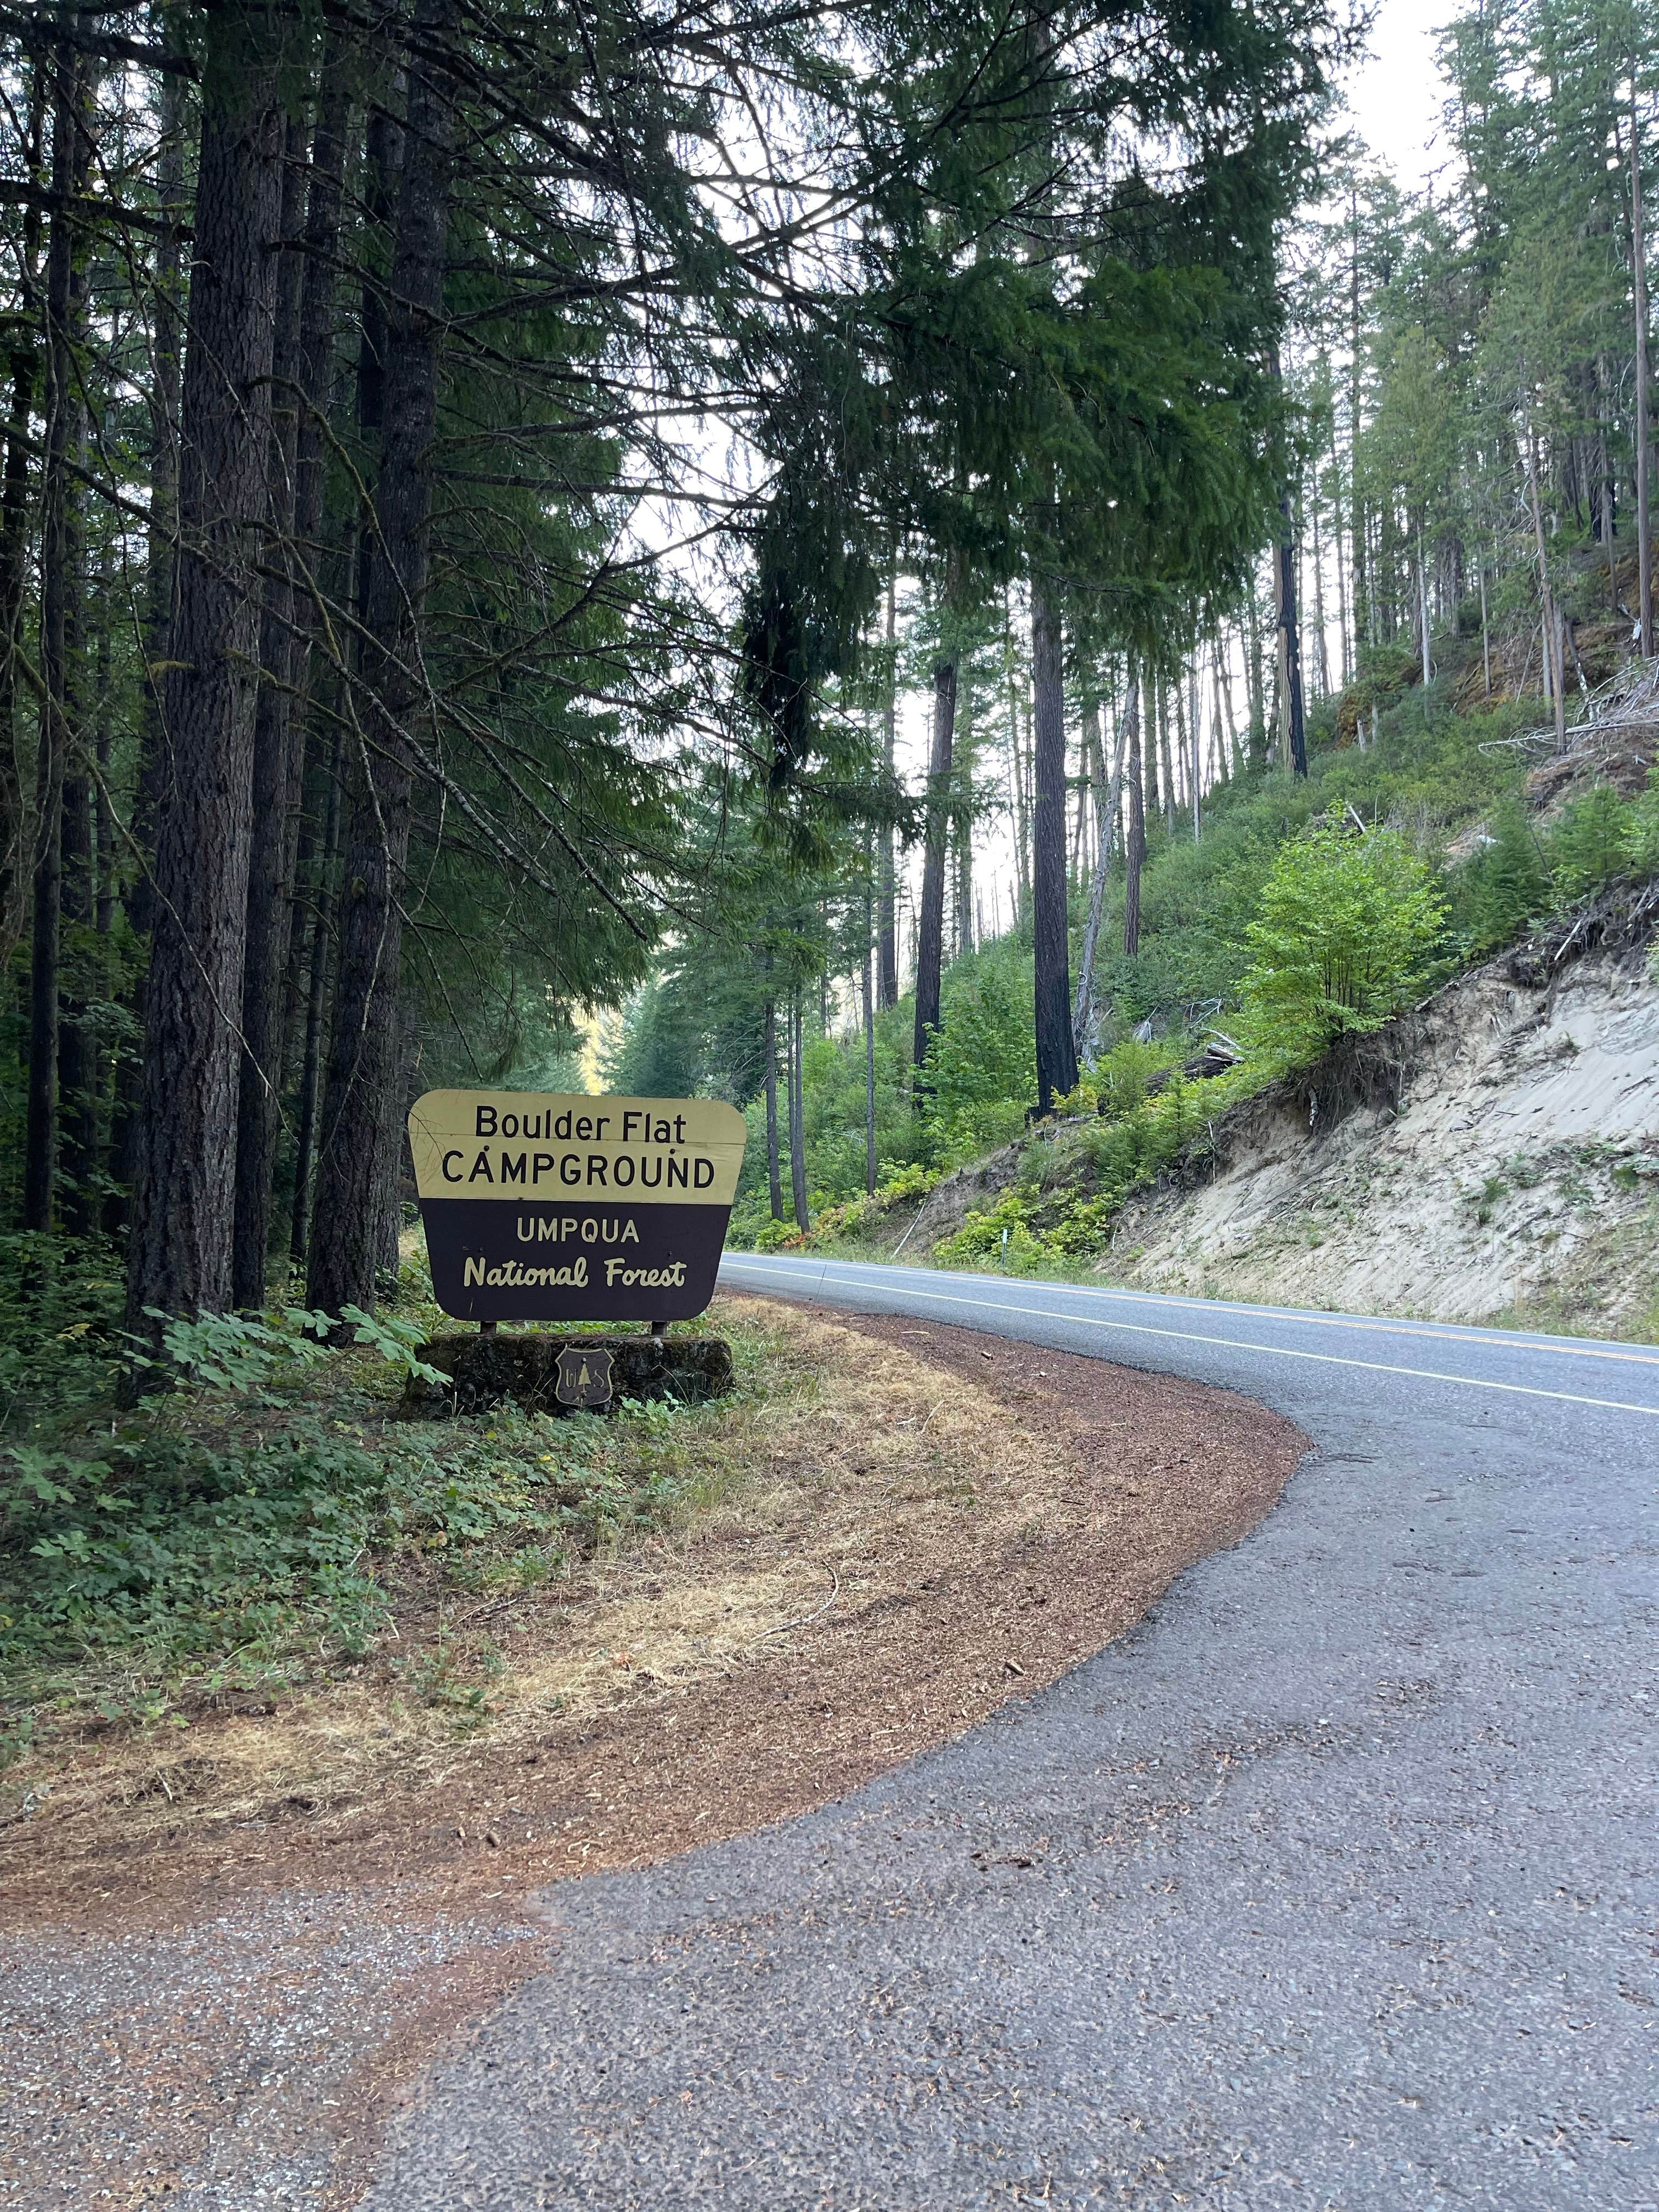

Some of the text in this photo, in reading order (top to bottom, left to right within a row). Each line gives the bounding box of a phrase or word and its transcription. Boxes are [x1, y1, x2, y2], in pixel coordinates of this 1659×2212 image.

[475, 1105, 686, 1144] Boulder Flat
[442, 1150, 714, 1188] CAMPGROUND
[517, 1217, 639, 1243] UMPQUA
[463, 1256, 687, 1288] National Forest
